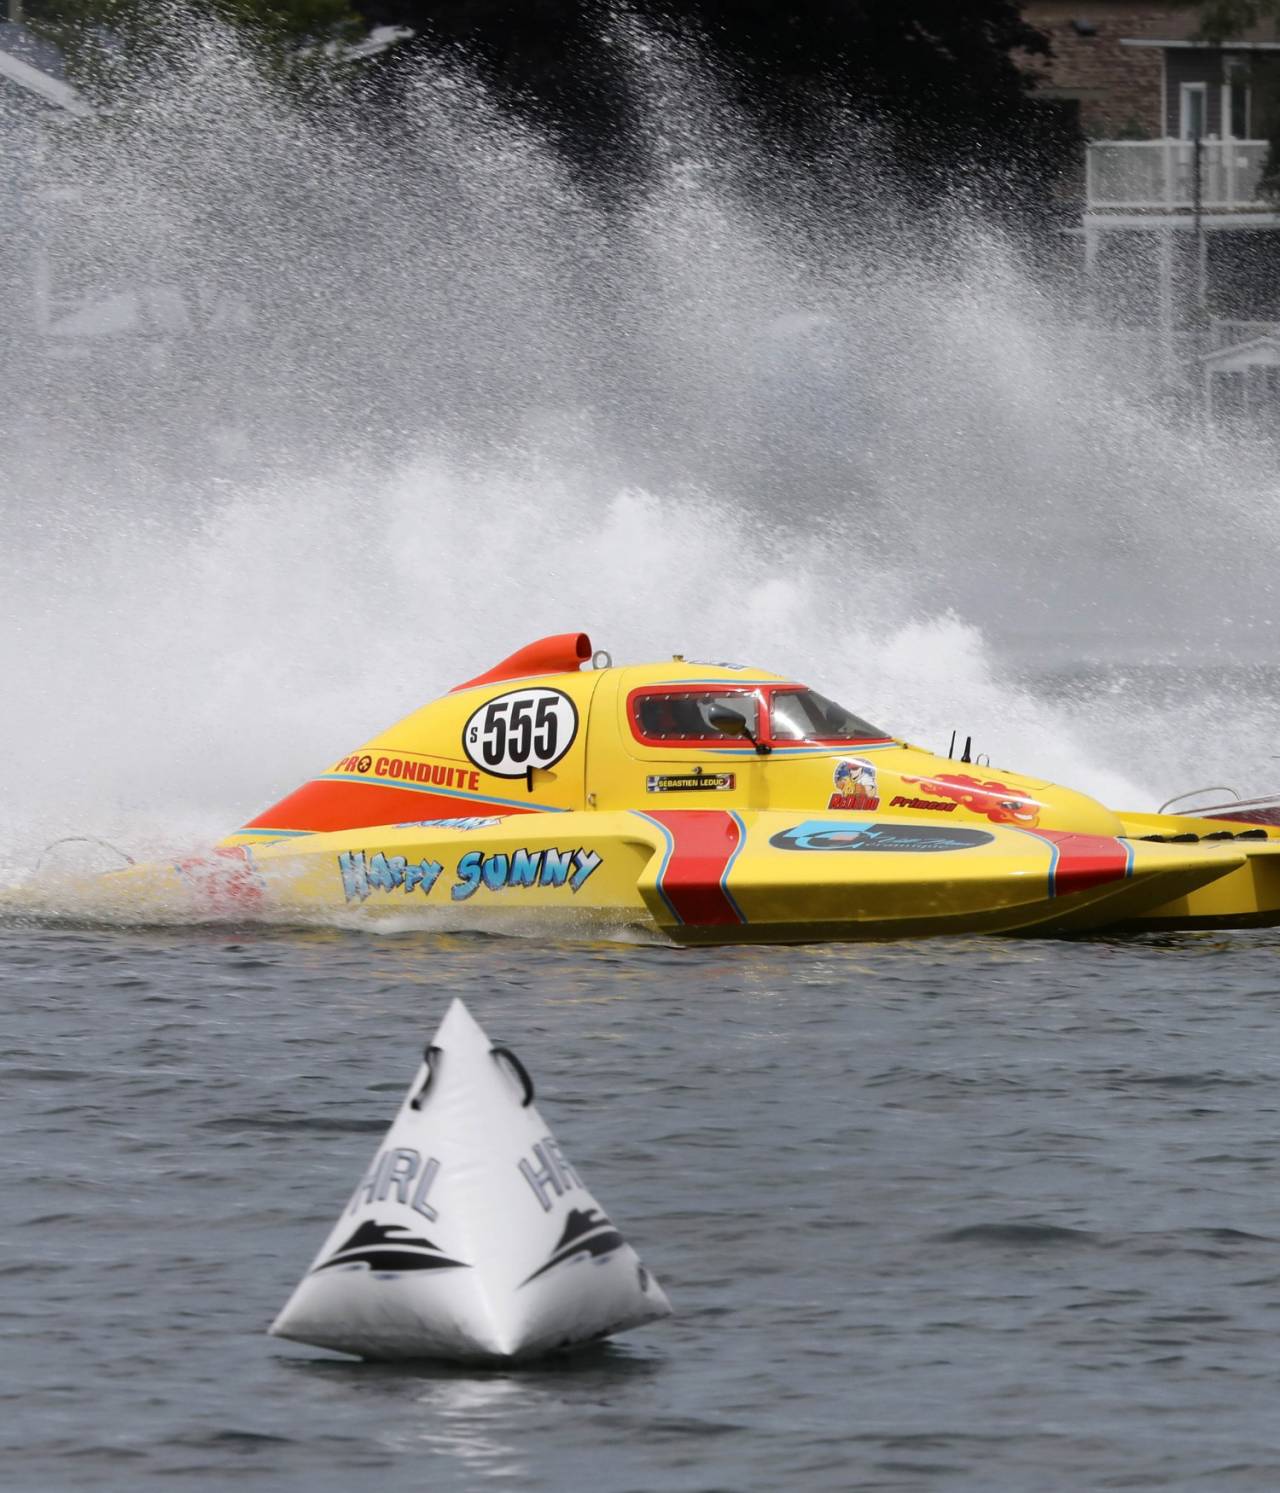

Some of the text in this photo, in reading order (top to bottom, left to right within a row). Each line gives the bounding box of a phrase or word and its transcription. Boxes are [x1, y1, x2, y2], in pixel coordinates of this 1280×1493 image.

[470, 696, 560, 766] S 555
[335, 755, 480, 791] PRO CONDUITE
[700, 778, 724, 787] LEDUC
